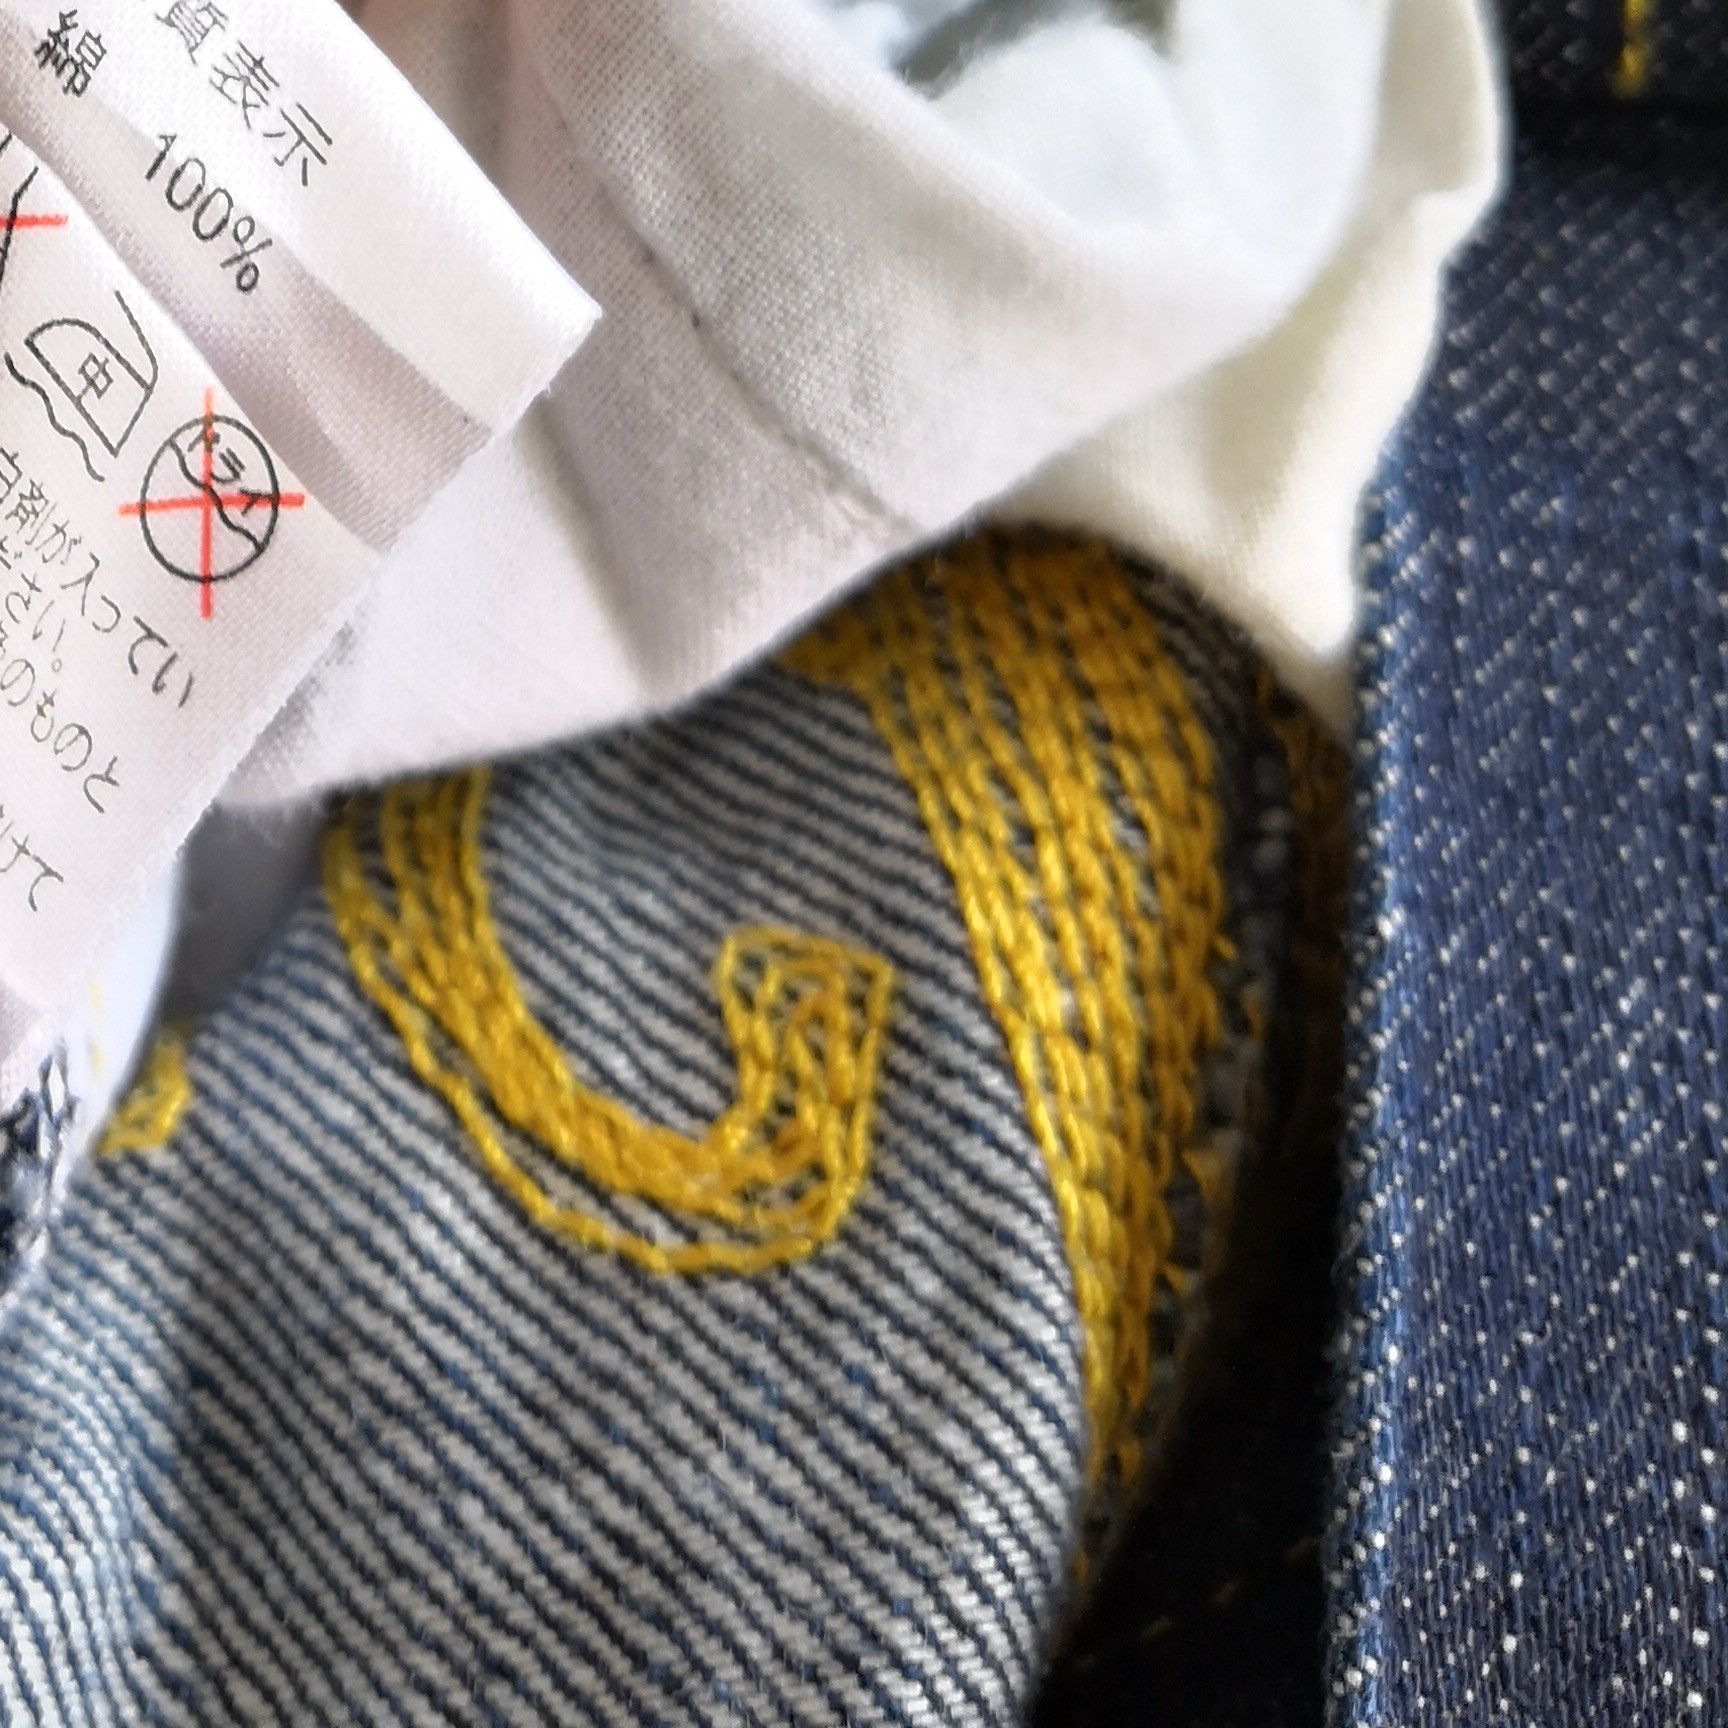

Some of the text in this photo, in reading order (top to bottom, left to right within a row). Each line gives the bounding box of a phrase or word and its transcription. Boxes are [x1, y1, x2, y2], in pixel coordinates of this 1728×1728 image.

[34, 11, 273, 295] 綿 100%
[73, 352, 114, 402] 中
